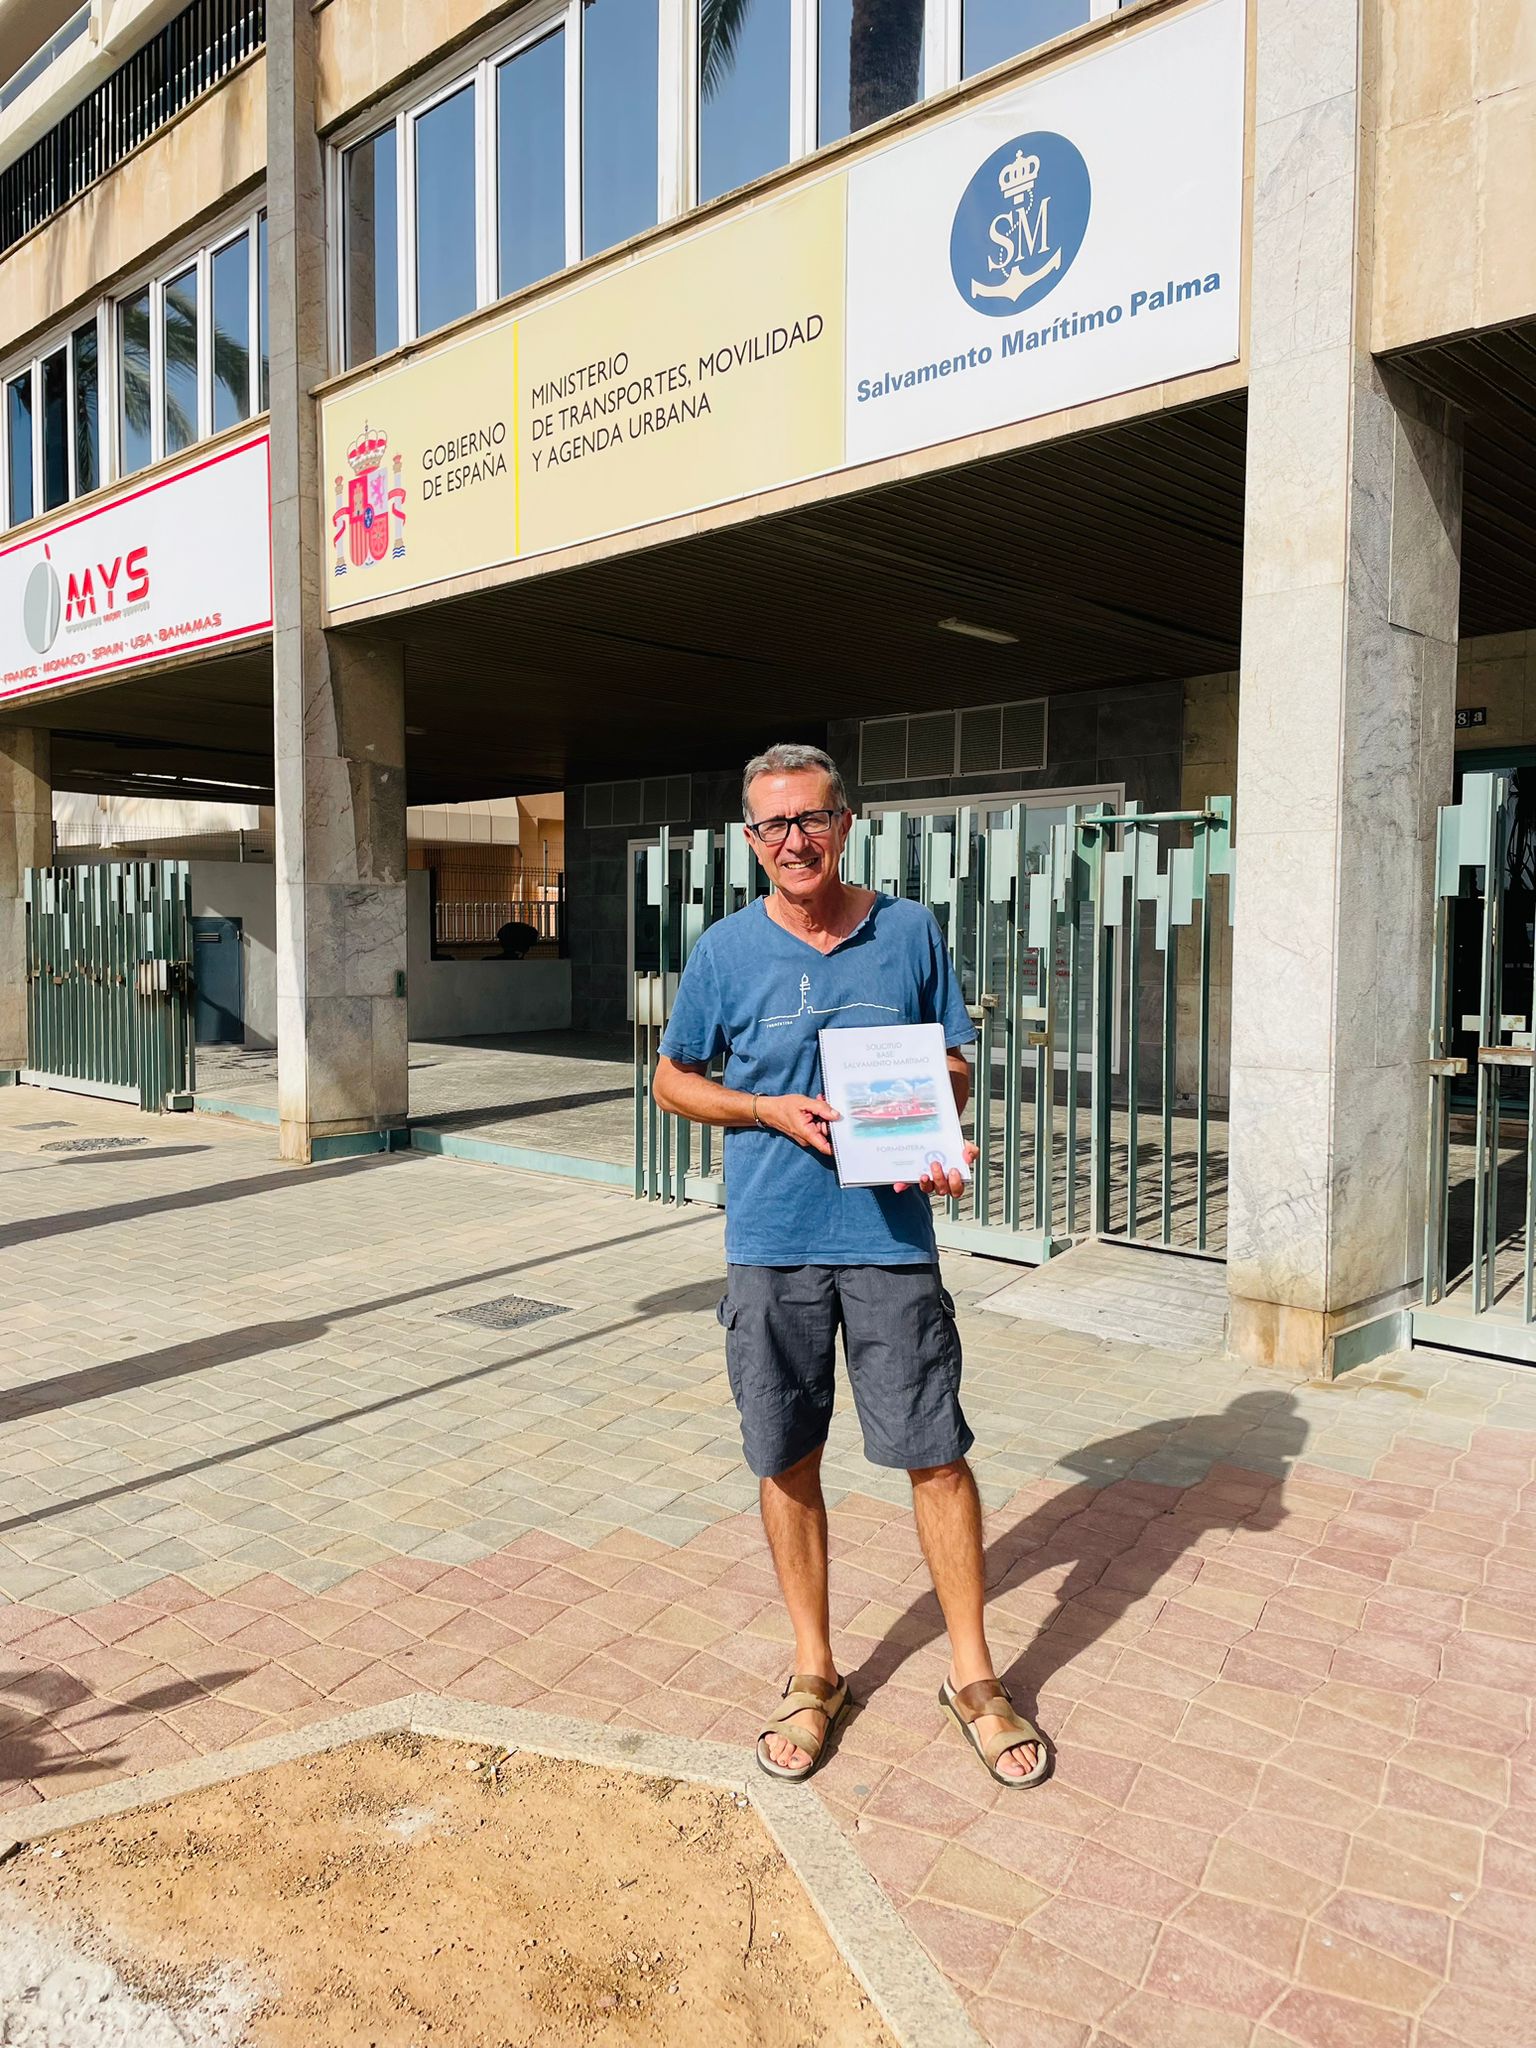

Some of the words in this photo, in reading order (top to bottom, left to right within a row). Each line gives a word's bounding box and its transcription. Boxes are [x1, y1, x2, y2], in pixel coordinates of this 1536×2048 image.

[987, 197, 1051, 271] SM
[857, 345, 992, 402] Salvamento
[1001, 305, 1122, 358] Marítimo
[1130, 272, 1220, 317] Palma
[532, 414, 553, 441] DE
[558, 364, 691, 430] TRANSPORTES,
[699, 314, 823, 381] MOVILIDAD
[532, 352, 628, 409] MINISTERIO
[422, 421, 506, 470] GOBIERNO
[532, 450, 542, 472] Y
[547, 423, 623, 468] AGENDA
[629, 392, 711, 439] URBANA
[423, 475, 442, 501] DE
[447, 452, 507, 492] ESPAÑA
[65, 546, 149, 621] MYS
[4, 666, 38, 684] FRANCE
[43, 652, 86, 672] MONACO
[91, 641, 124, 660] SPAIN
[130, 634, 154, 650] USA
[159, 612, 222, 641] BAHAMAS
[843, 1059, 892, 1069] SALVAMENTO
[876, 1144, 925, 1152] FORMENTERA
